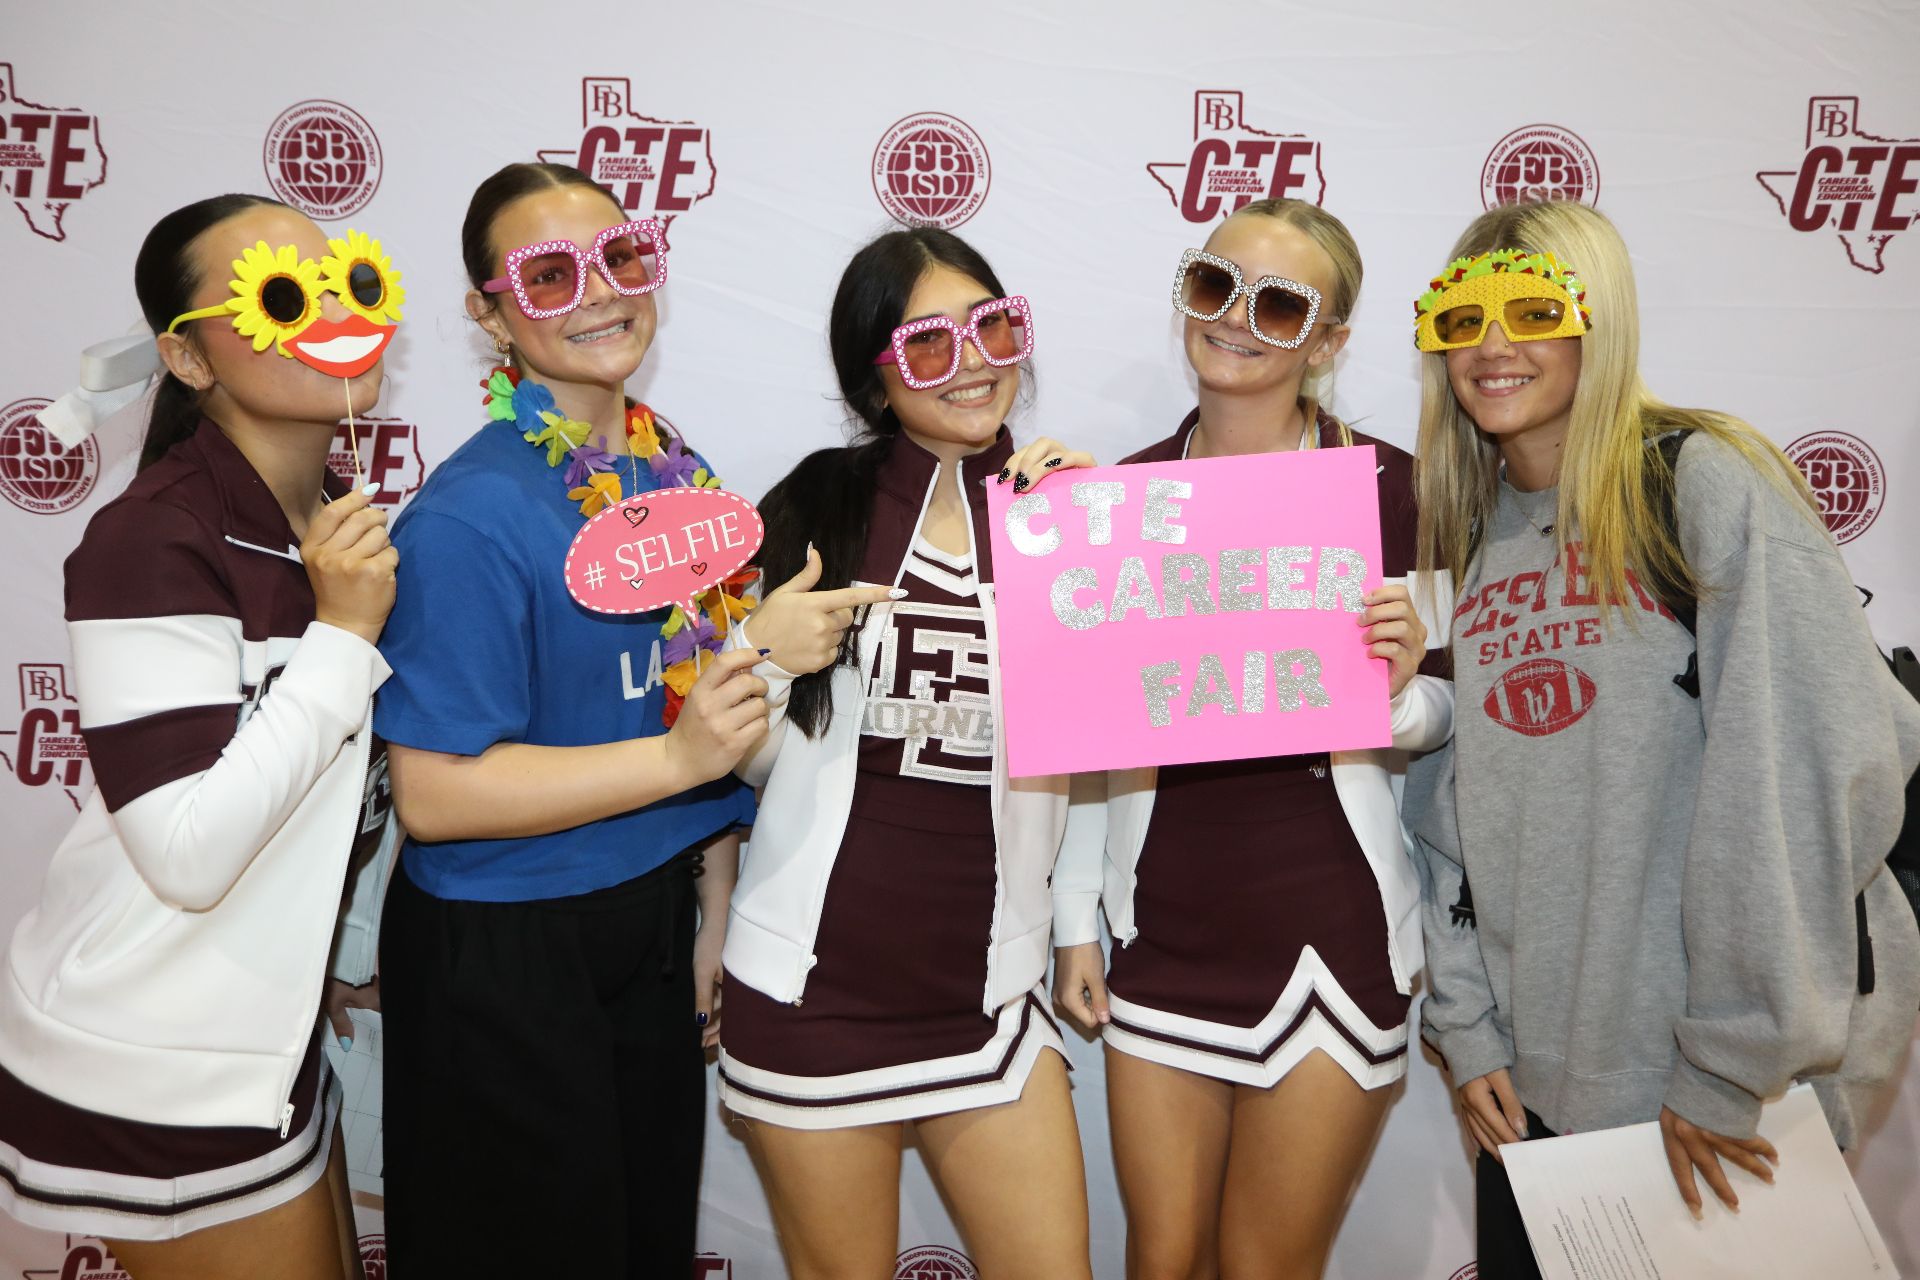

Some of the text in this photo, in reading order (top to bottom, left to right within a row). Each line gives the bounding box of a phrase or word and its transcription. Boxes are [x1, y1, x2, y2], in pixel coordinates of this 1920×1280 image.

[287, 106, 338, 121] INDEPENDENT
[339, 111, 364, 136] SCHOOL
[591, 85, 622, 118] FB
[1203, 97, 1234, 131] FB
[1816, 104, 1848, 138] FB
[0, 113, 90, 199] TE
[577, 126, 703, 211] CTE
[898, 118, 949, 133] INDEPENDENT
[950, 123, 975, 148] SCHOOL
[972, 147, 985, 179] DISTRICT
[1509, 131, 1560, 146] INDEPENDENT
[1560, 135, 1585, 160] SCHOOL
[1181, 139, 1314, 223] CTE
[1789, 145, 1920, 232] CTE
[1817, 185, 1874, 193] TECHNICAL
[1818, 177, 1869, 185] CAREER &
[334, 425, 410, 504] TE
[1797, 436, 1880, 495] INDEPENDENT SCHOOL DISTRICT
[615, 512, 745, 581] SELFIE
[1005, 477, 1192, 557] CTE
[1050, 546, 1367, 630] CAREER
[1479, 618, 1600, 665] STATE
[27, 670, 58, 701] FB
[1140, 648, 1331, 727] FAIR
[16, 708, 83, 786] CT
[902, 1250, 949, 1263] INDEPENDENT
[949, 1255, 971, 1275] SCHOOL
